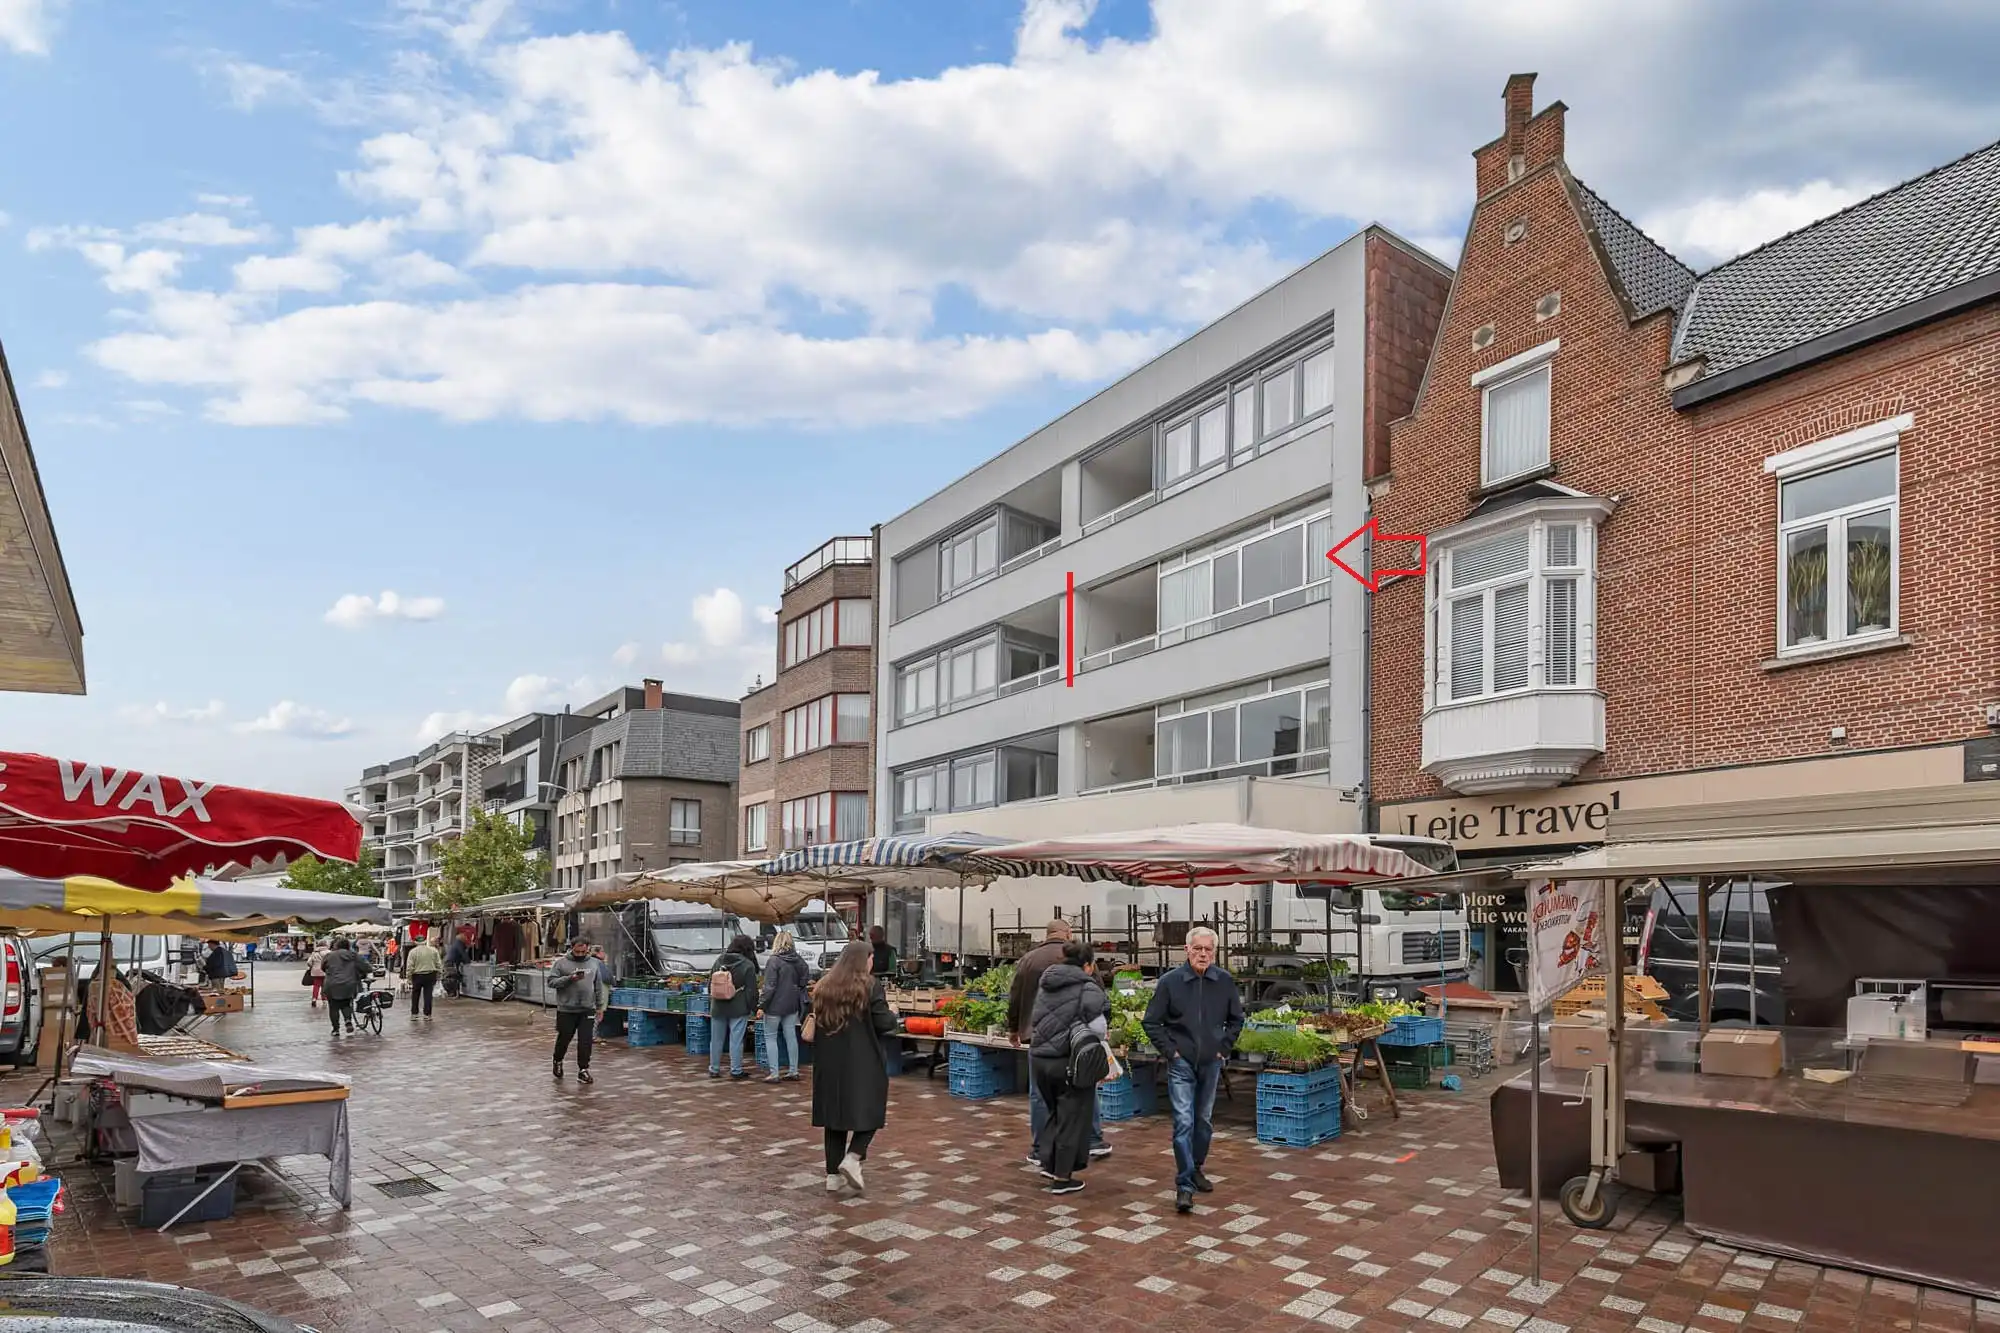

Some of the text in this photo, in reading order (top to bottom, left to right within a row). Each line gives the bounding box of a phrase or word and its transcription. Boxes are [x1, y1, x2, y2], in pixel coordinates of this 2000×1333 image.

[57, 759, 216, 823] WAX
[1406, 807, 1480, 841] Leie
[1470, 907, 1498, 924] the
